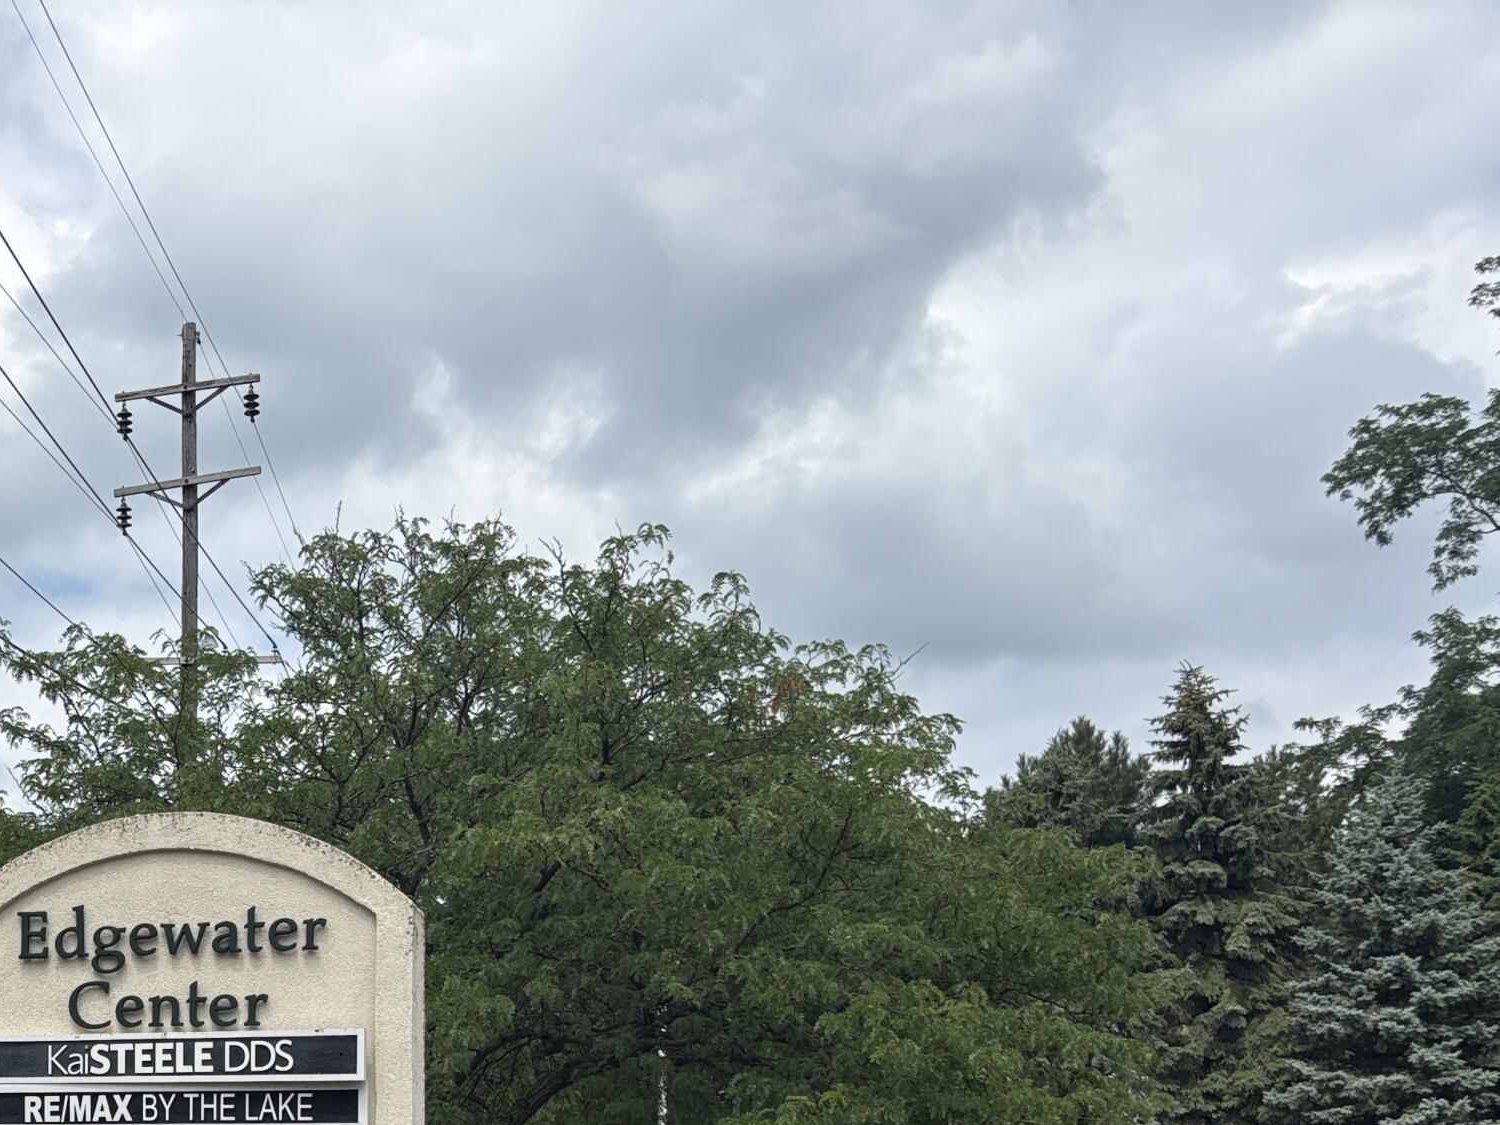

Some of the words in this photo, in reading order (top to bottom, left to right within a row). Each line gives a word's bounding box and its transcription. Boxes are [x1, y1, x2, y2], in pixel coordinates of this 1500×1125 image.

[17, 904, 328, 974] Edgewater
[68, 980, 269, 1030] Center
[224, 1039, 294, 1072] DDS
[24, 1093, 133, 1123] RE/MAX
[142, 1093, 176, 1121] BY
[184, 1092, 236, 1121] THE
[245, 1092, 314, 1121] LAKE
